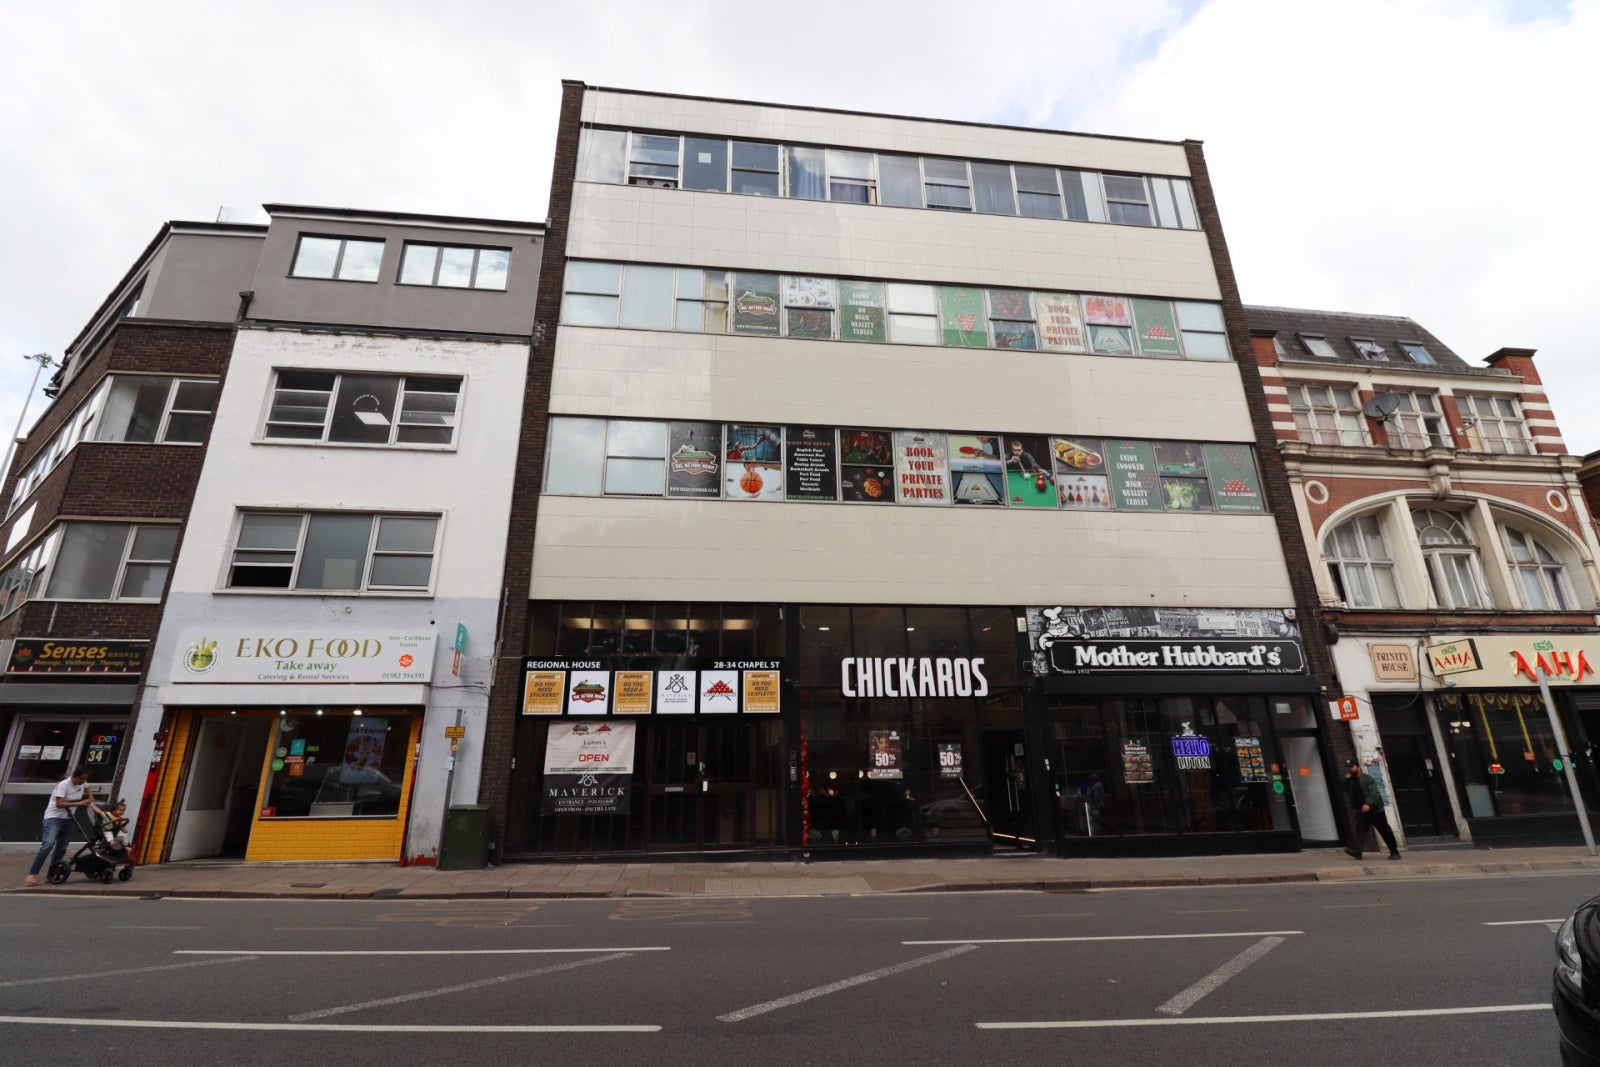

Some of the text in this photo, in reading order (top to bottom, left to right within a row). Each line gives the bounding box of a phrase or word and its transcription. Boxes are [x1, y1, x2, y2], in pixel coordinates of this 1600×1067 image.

[1047, 305, 1070, 314] BOOK
[1050, 315, 1071, 324] YOUR
[1046, 326, 1079, 335] PRIVATE
[1047, 336, 1081, 345] PARTIES
[906, 447, 934, 457] BOOK
[908, 460, 934, 471] YOUR
[901, 474, 942, 484] PRIVATE
[902, 487, 944, 499] PARTIES
[1122, 489, 1148, 497] QUALITY
[1126, 498, 1148, 506] TABLES
[40, 642, 108, 659] Senses
[236, 638, 382, 658] EKO FOOD
[1074, 645, 1281, 667] Mother Hubbard's
[1376, 652, 1408, 660] TRINITY
[1434, 651, 1472, 669] AAHA
[275, 661, 338, 672] Take away
[526, 661, 600, 669] REGIONAL HOUSE
[714, 661, 780, 669] 28-34 CHAPEL ST
[1382, 663, 1408, 671] HOUSE
[1509, 649, 1594, 682] AAHA
[841, 657, 989, 698] CHICKAROS
[92, 736, 117, 744] open
[1172, 739, 1210, 756] HELLO
[88, 750, 103, 762] 34
[875, 753, 896, 766] 50%
[940, 752, 961, 766] 50%
[1177, 756, 1211, 769] LUTON
[550, 788, 625, 798] MAVERICK
